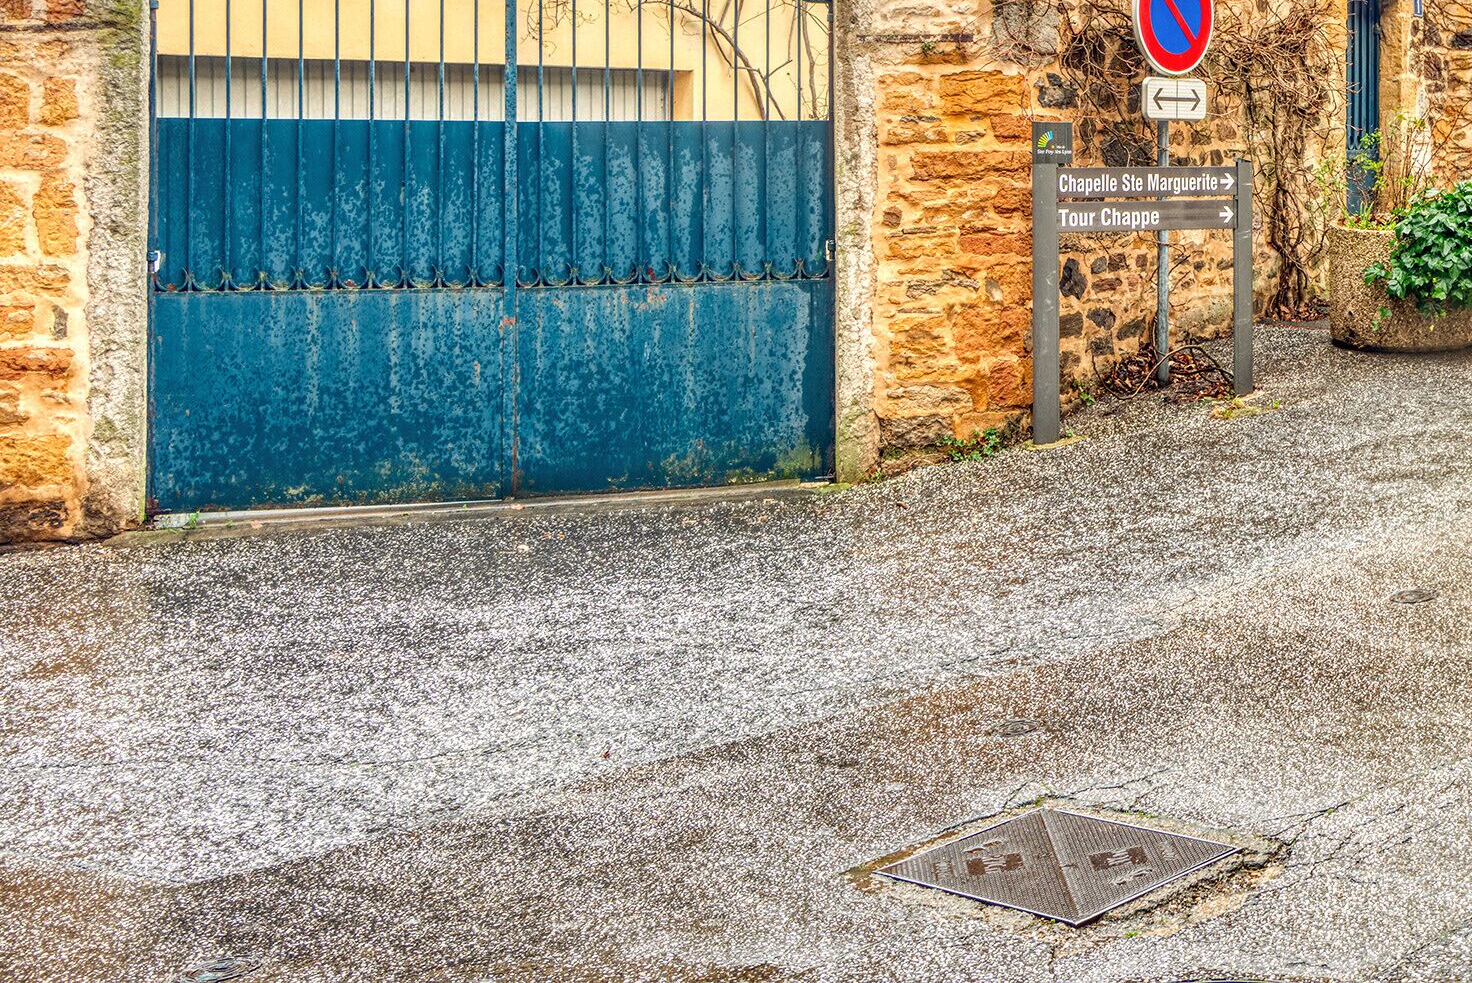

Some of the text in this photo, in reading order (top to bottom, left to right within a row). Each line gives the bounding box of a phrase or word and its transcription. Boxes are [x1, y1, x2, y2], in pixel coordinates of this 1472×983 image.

[1059, 173, 1218, 195] Chapelle Ste Marguerite
[1058, 207, 1160, 229] Tour Chappe
